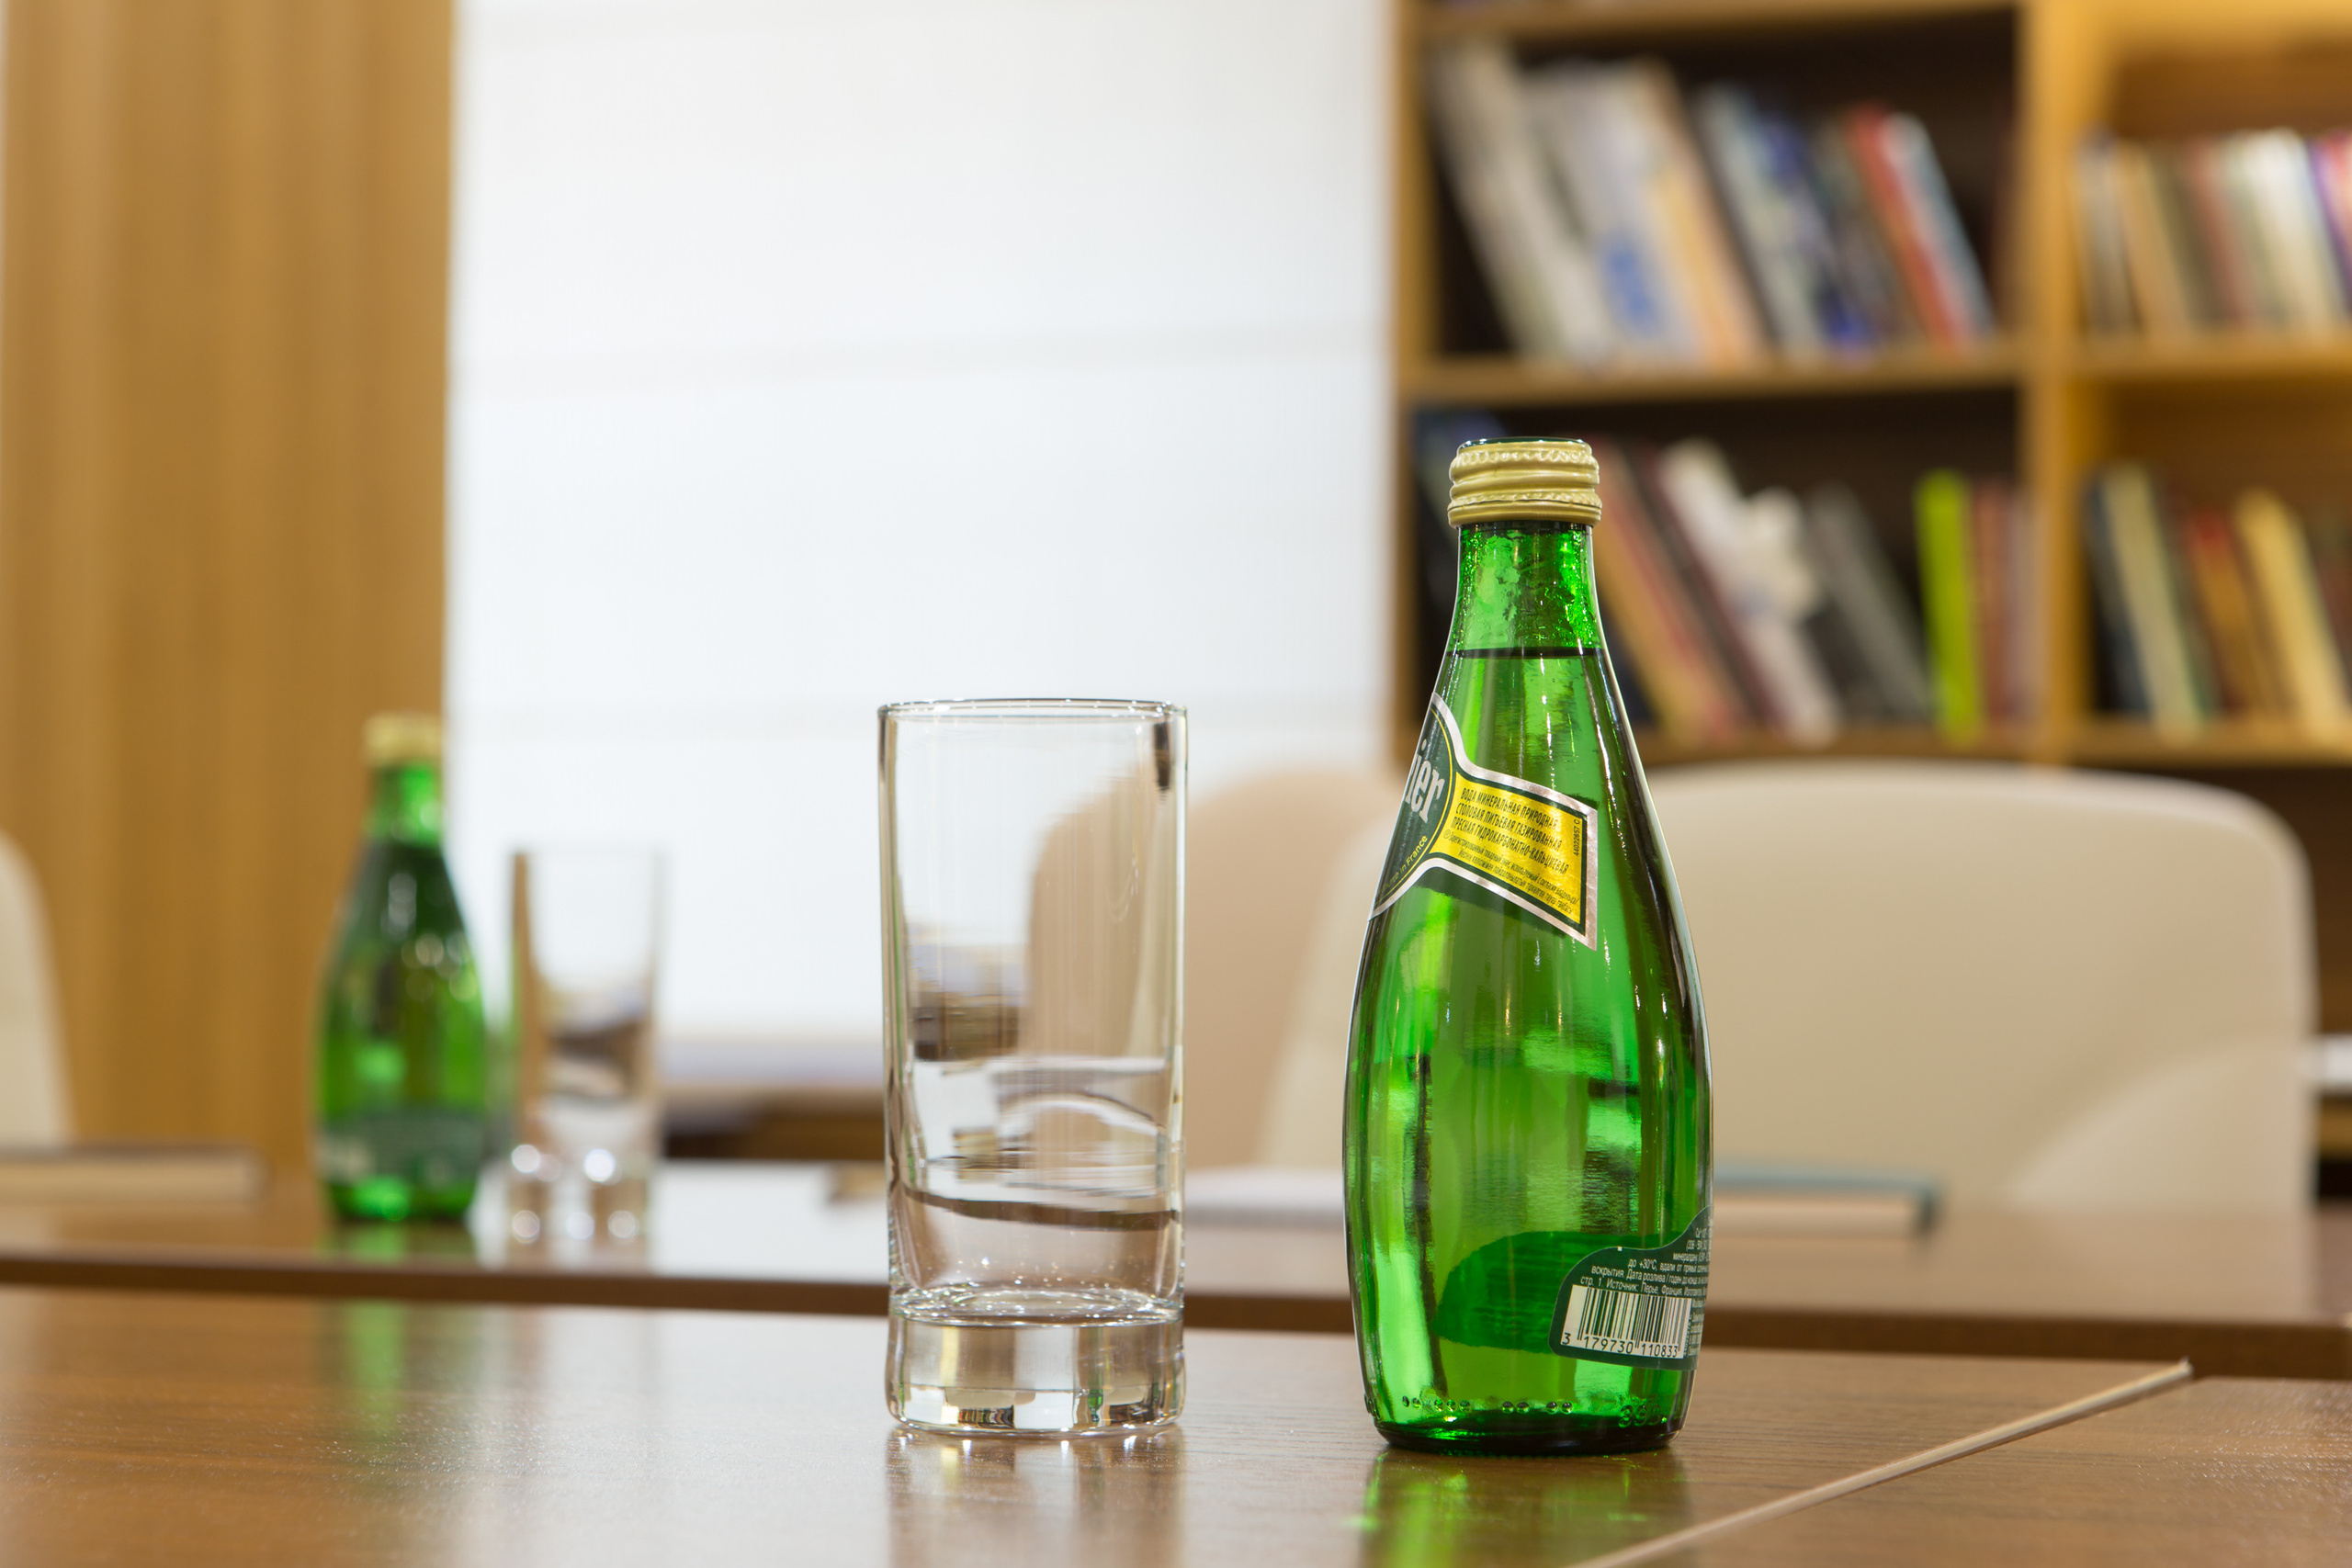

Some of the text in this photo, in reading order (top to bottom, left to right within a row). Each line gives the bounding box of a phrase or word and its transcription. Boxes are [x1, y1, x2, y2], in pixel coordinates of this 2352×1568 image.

[1461, 787, 1558, 830] ВОДА МИНЕРАЛЬНАЯ ПРИРОДНАЯ
[1455, 802, 1563, 852] СТОЛОВАЯ ПИТЬЕВАЯ ГАЗИРОВАННАЯ
[1399, 864, 1408, 874] in
[1406, 835, 1429, 866] France
[1451, 816, 1569, 874] ПРЕСНАЯ ГИДРОКАРБОНАТНО-КАЛЬЦИЕВАЯ
[1591, 1265, 1625, 1278] вскрытия.
[1626, 1269, 1643, 1280] Дата
[1627, 1258, 1637, 1269] до
[1580, 1276, 1594, 1288] стр.
[1562, 1332, 1571, 1345] 3
[1583, 1336, 1634, 1355] 179730
[1641, 1343, 1679, 1359] 110833
